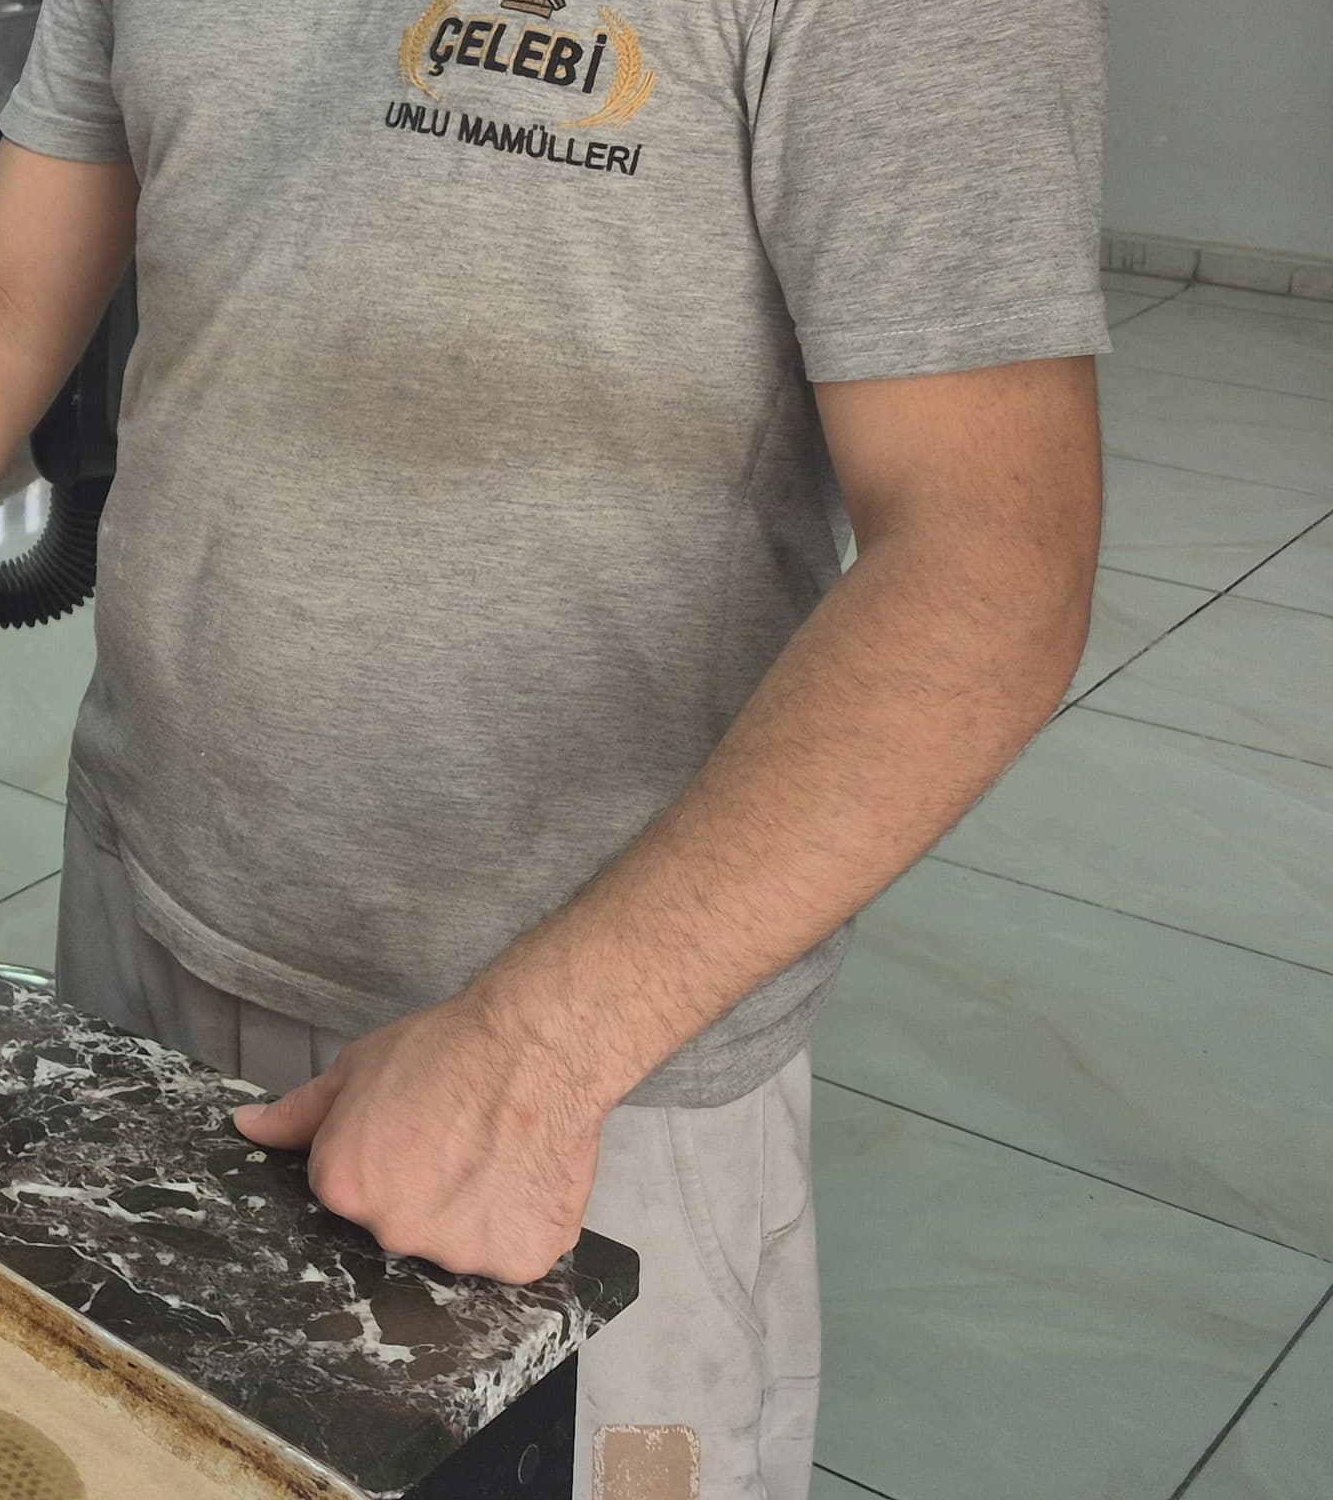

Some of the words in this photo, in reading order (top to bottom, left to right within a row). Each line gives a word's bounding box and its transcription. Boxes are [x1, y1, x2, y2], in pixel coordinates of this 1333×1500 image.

[428, 16, 608, 94] ÇELEBİ
[384, 101, 450, 137] UNLU
[458, 112, 643, 176] MAMÜLLERİ
